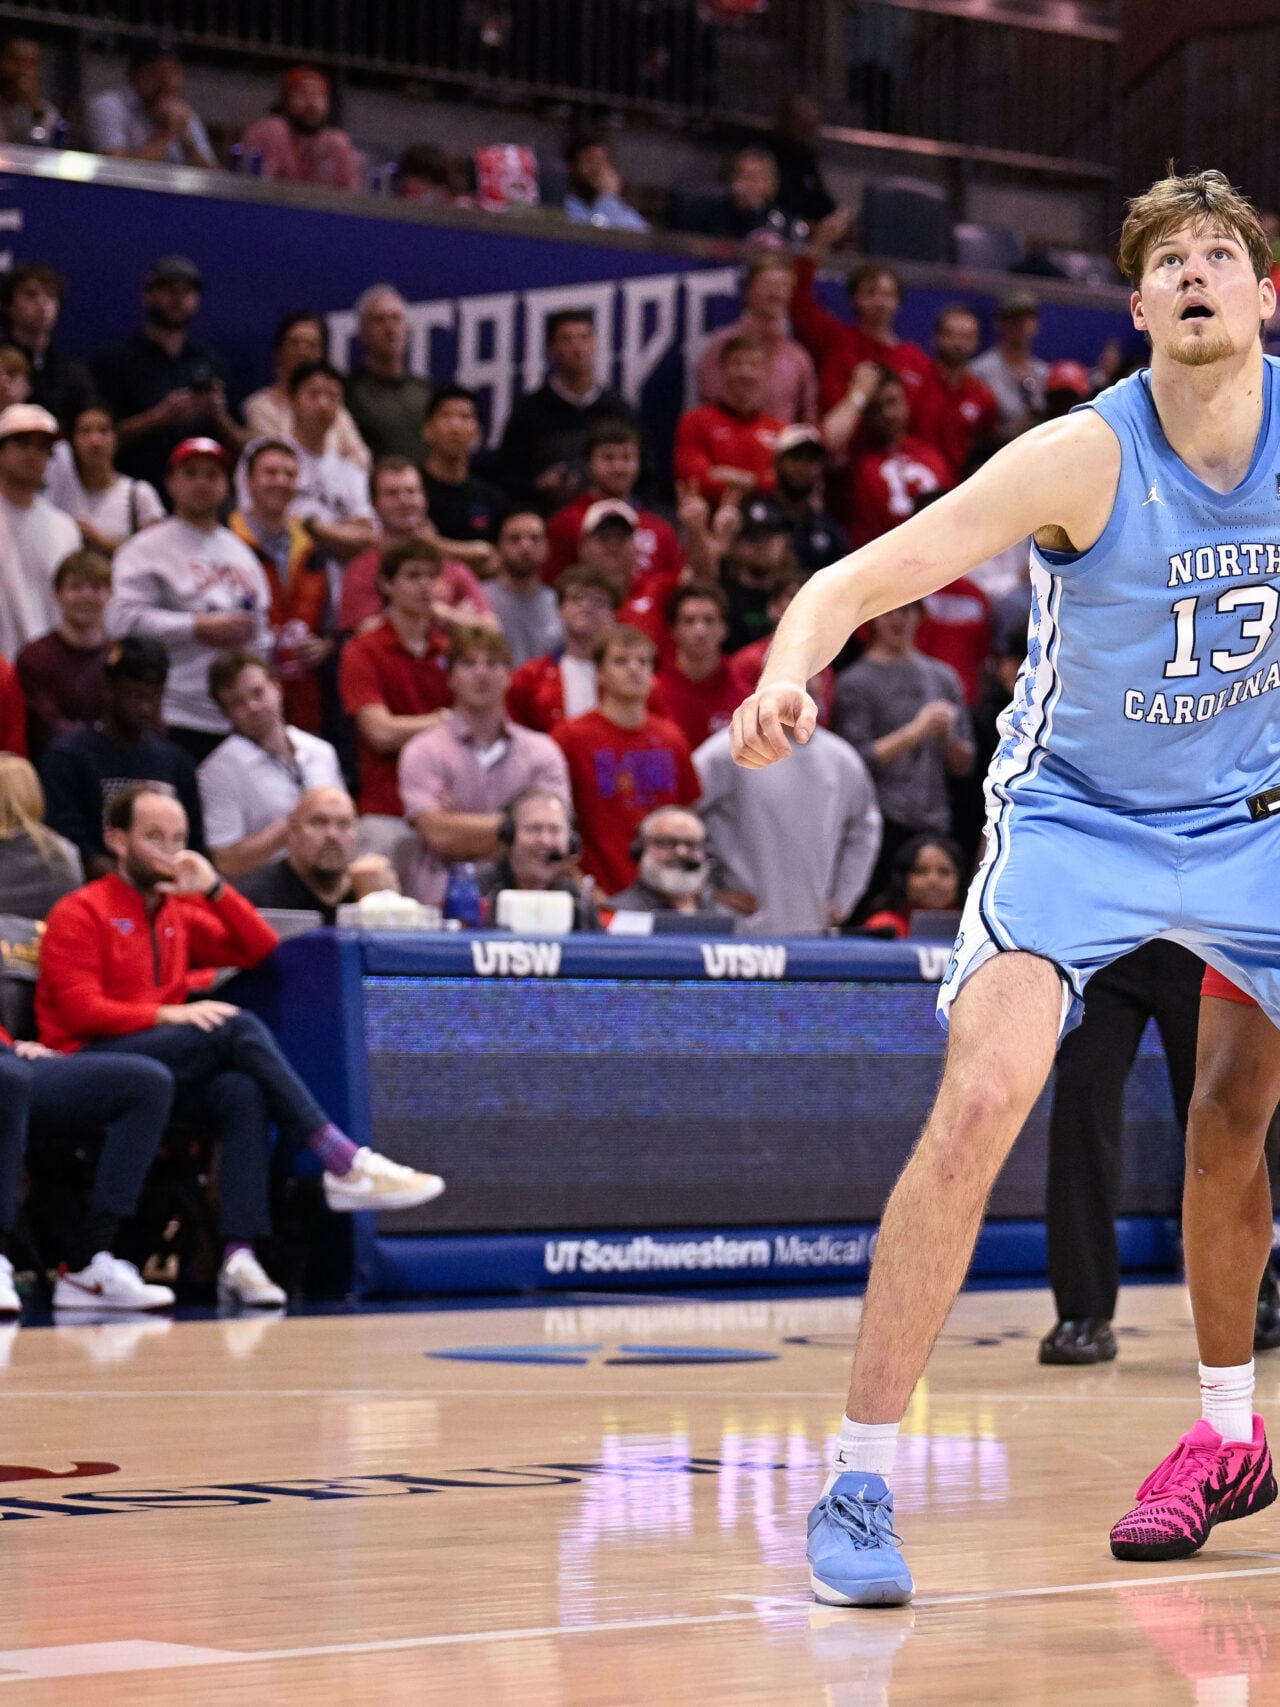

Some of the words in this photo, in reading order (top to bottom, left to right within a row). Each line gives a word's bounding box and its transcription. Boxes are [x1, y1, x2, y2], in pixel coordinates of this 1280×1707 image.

[1163, 584, 1280, 679] 13
[470, 940, 562, 977] UTSW
[700, 943, 788, 979] UTSW
[544, 1241, 581, 1273] UT
[581, 1235, 771, 1272] Southwestern
[773, 1233, 867, 1266] Medical
